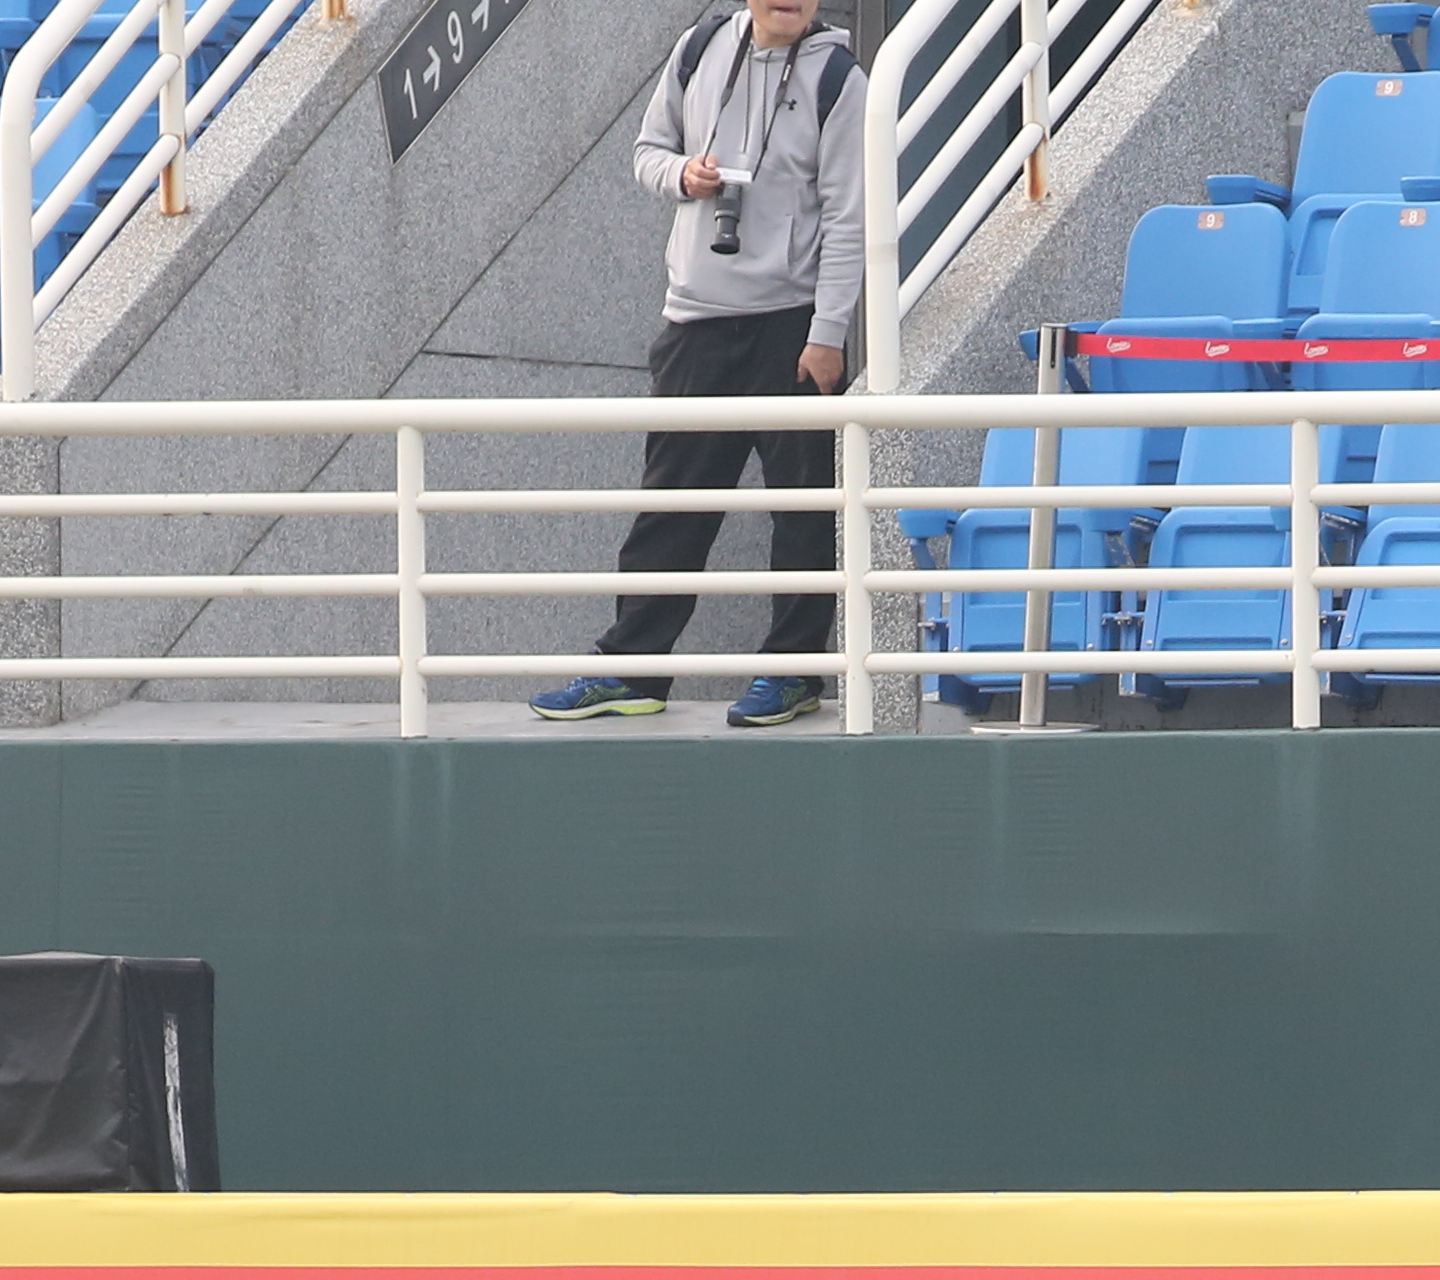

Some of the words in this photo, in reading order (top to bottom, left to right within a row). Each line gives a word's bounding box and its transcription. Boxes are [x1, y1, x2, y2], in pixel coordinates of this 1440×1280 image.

[403, 68, 418, 119] 1
[446, 10, 464, 64] 9
[1384, 80, 1394, 95] 9
[1206, 213, 1215, 228] 9
[1408, 210, 1418, 225] 8
